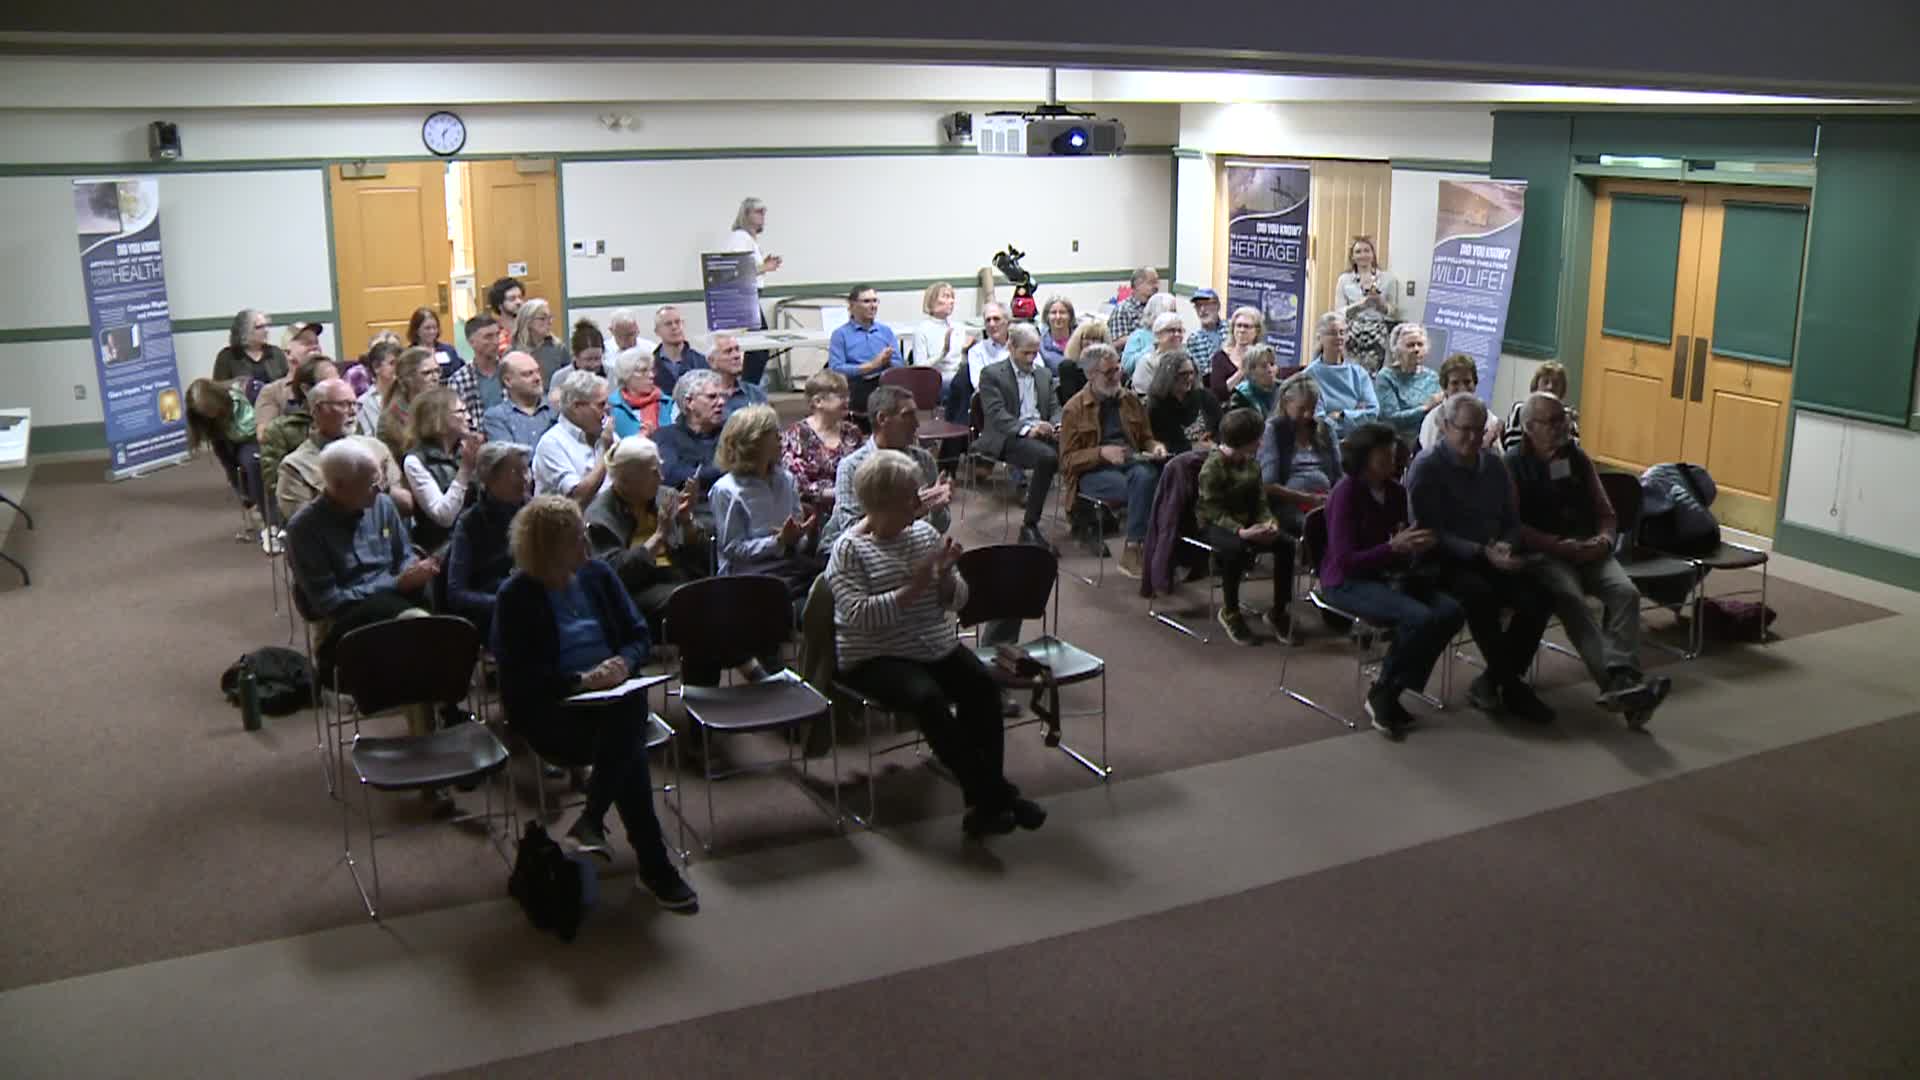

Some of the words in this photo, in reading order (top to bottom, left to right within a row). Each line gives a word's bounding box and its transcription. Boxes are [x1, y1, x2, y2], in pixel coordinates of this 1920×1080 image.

[1257, 223, 1267, 234] DID
[1267, 223, 1279, 234] YOU
[1280, 225, 1302, 236] KNOW?
[128, 242, 140, 254] YOU
[1230, 239, 1299, 263] HERITAGE!
[1460, 244, 1472, 256] DID
[1472, 245, 1485, 258] YOU
[1486, 247, 1511, 260] KNOW?
[112, 263, 161, 282] HEALTH
[1432, 264, 1505, 290] WILDLIFE!
